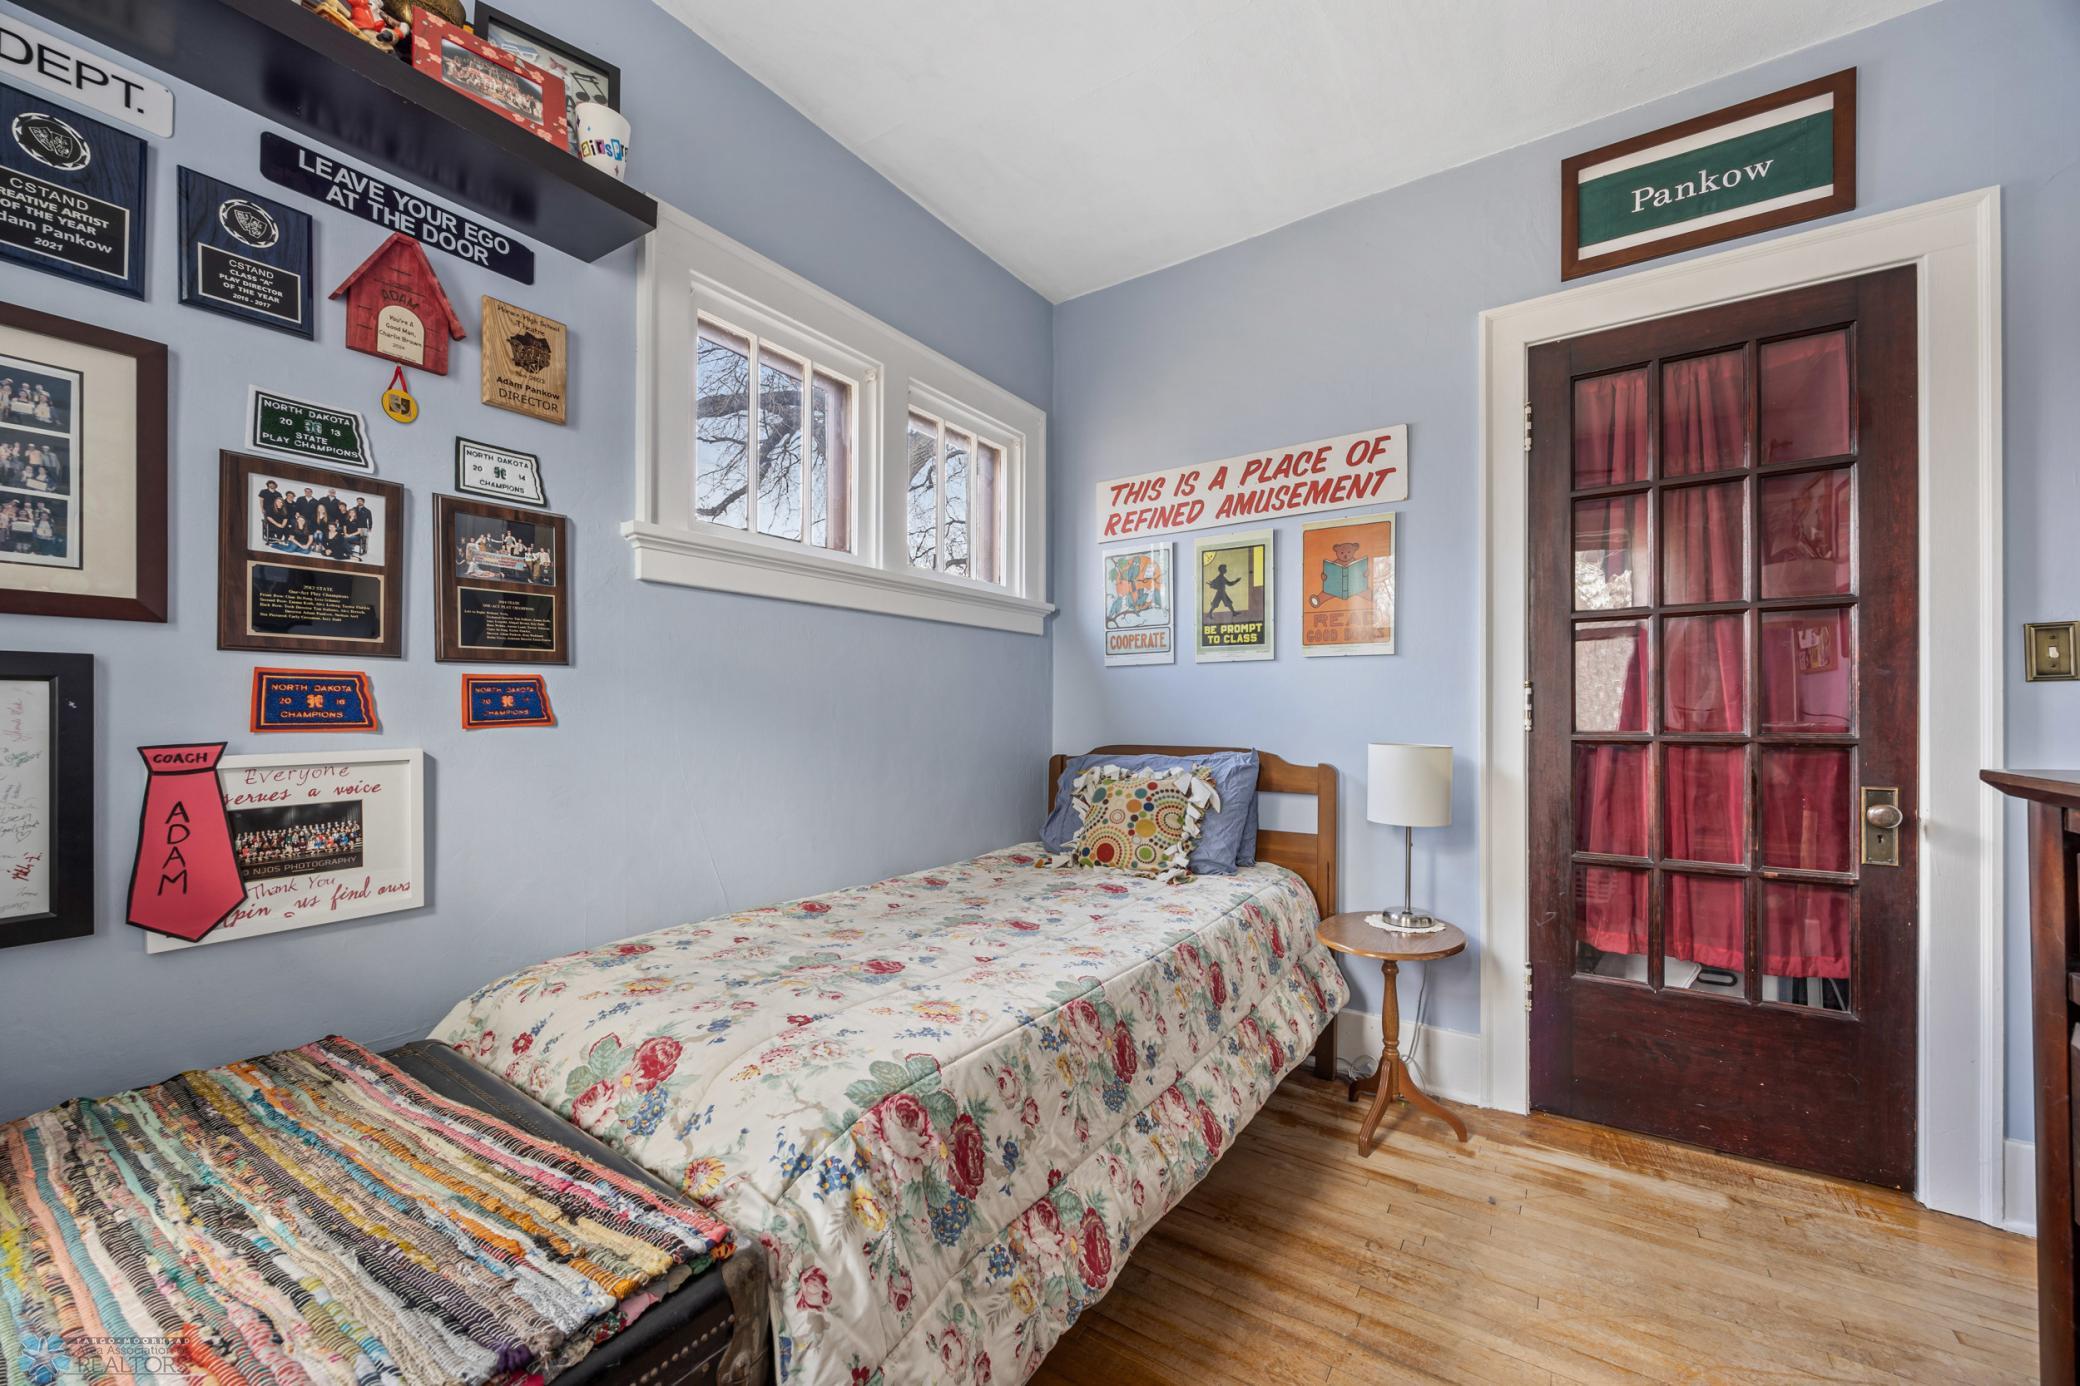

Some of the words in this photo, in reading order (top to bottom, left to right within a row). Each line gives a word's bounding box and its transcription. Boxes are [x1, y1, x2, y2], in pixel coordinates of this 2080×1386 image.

[0, 29, 144, 114] DEPT.
[10, 177, 88, 210] CSTAND
[1631, 159, 1774, 213] Pankow
[0, 186, 58, 212] REATIVE
[61, 208, 110, 229] ARTIST
[298, 149, 385, 202] LEAVE
[393, 191, 457, 234] YOUR
[464, 222, 510, 255] EGO
[0, 199, 21, 209] OF
[25, 206, 54, 222] THE
[57, 216, 97, 236] YEAR
[326, 185, 359, 211] AT
[367, 199, 416, 236] THE
[423, 224, 489, 266] DOOR
[0, 211, 36, 231] dam
[42, 224, 112, 254] Pankow
[34, 237, 64, 251] 2021
[229, 259, 274, 279] CSTAND
[230, 269, 257, 282] CLASS
[219, 273, 240, 284] PLAY
[242, 280, 283, 297] DIRECTOR
[237, 286, 255, 296] THE
[257, 292, 280, 303] YEAR
[496, 376, 522, 390] Adam
[525, 383, 560, 400] Pankow
[499, 388, 559, 413] DIRECTOR
[264, 399, 303, 415] NORTH
[308, 411, 351, 426] DAKOTA
[280, 417, 293, 426] 20
[262, 432, 290, 444] PLAY
[294, 440, 359, 458] CHAMPIONS
[295, 432, 328, 445] STATE
[466, 449, 494, 461] NORTH
[497, 456, 529, 469] DAKOTA
[473, 464, 483, 472] 20
[1110, 477, 1166, 507] THIS
[1173, 470, 1200, 497] IS
[1208, 466, 1229, 491] A
[1239, 446, 1332, 487] PLACE
[1345, 435, 1392, 467] OF
[479, 479, 525, 494] CHAMPIONS
[1103, 499, 1205, 537] REFINED
[1216, 467, 1397, 519] AMUSEMENT
[1204, 625, 1217, 635] BE
[1220, 623, 1263, 634] PROMPT
[1207, 635, 1220, 644] TO
[1223, 633, 1258, 643] CLASS
[1307, 629, 1338, 642] GOOD
[1110, 632, 1167, 650] COOPERATE
[271, 684, 308, 692] NORTH
[314, 684, 352, 692] DAKOTA
[153, 752, 208, 763] COACH
[244, 765, 350, 786] Everyone
[335, 779, 382, 796] voice
[158, 800, 190, 896] ADAM
[284, 856, 357, 870] PHOTOGRAPHY
[248, 878, 298, 900] Thank
[308, 876, 335, 889] You
